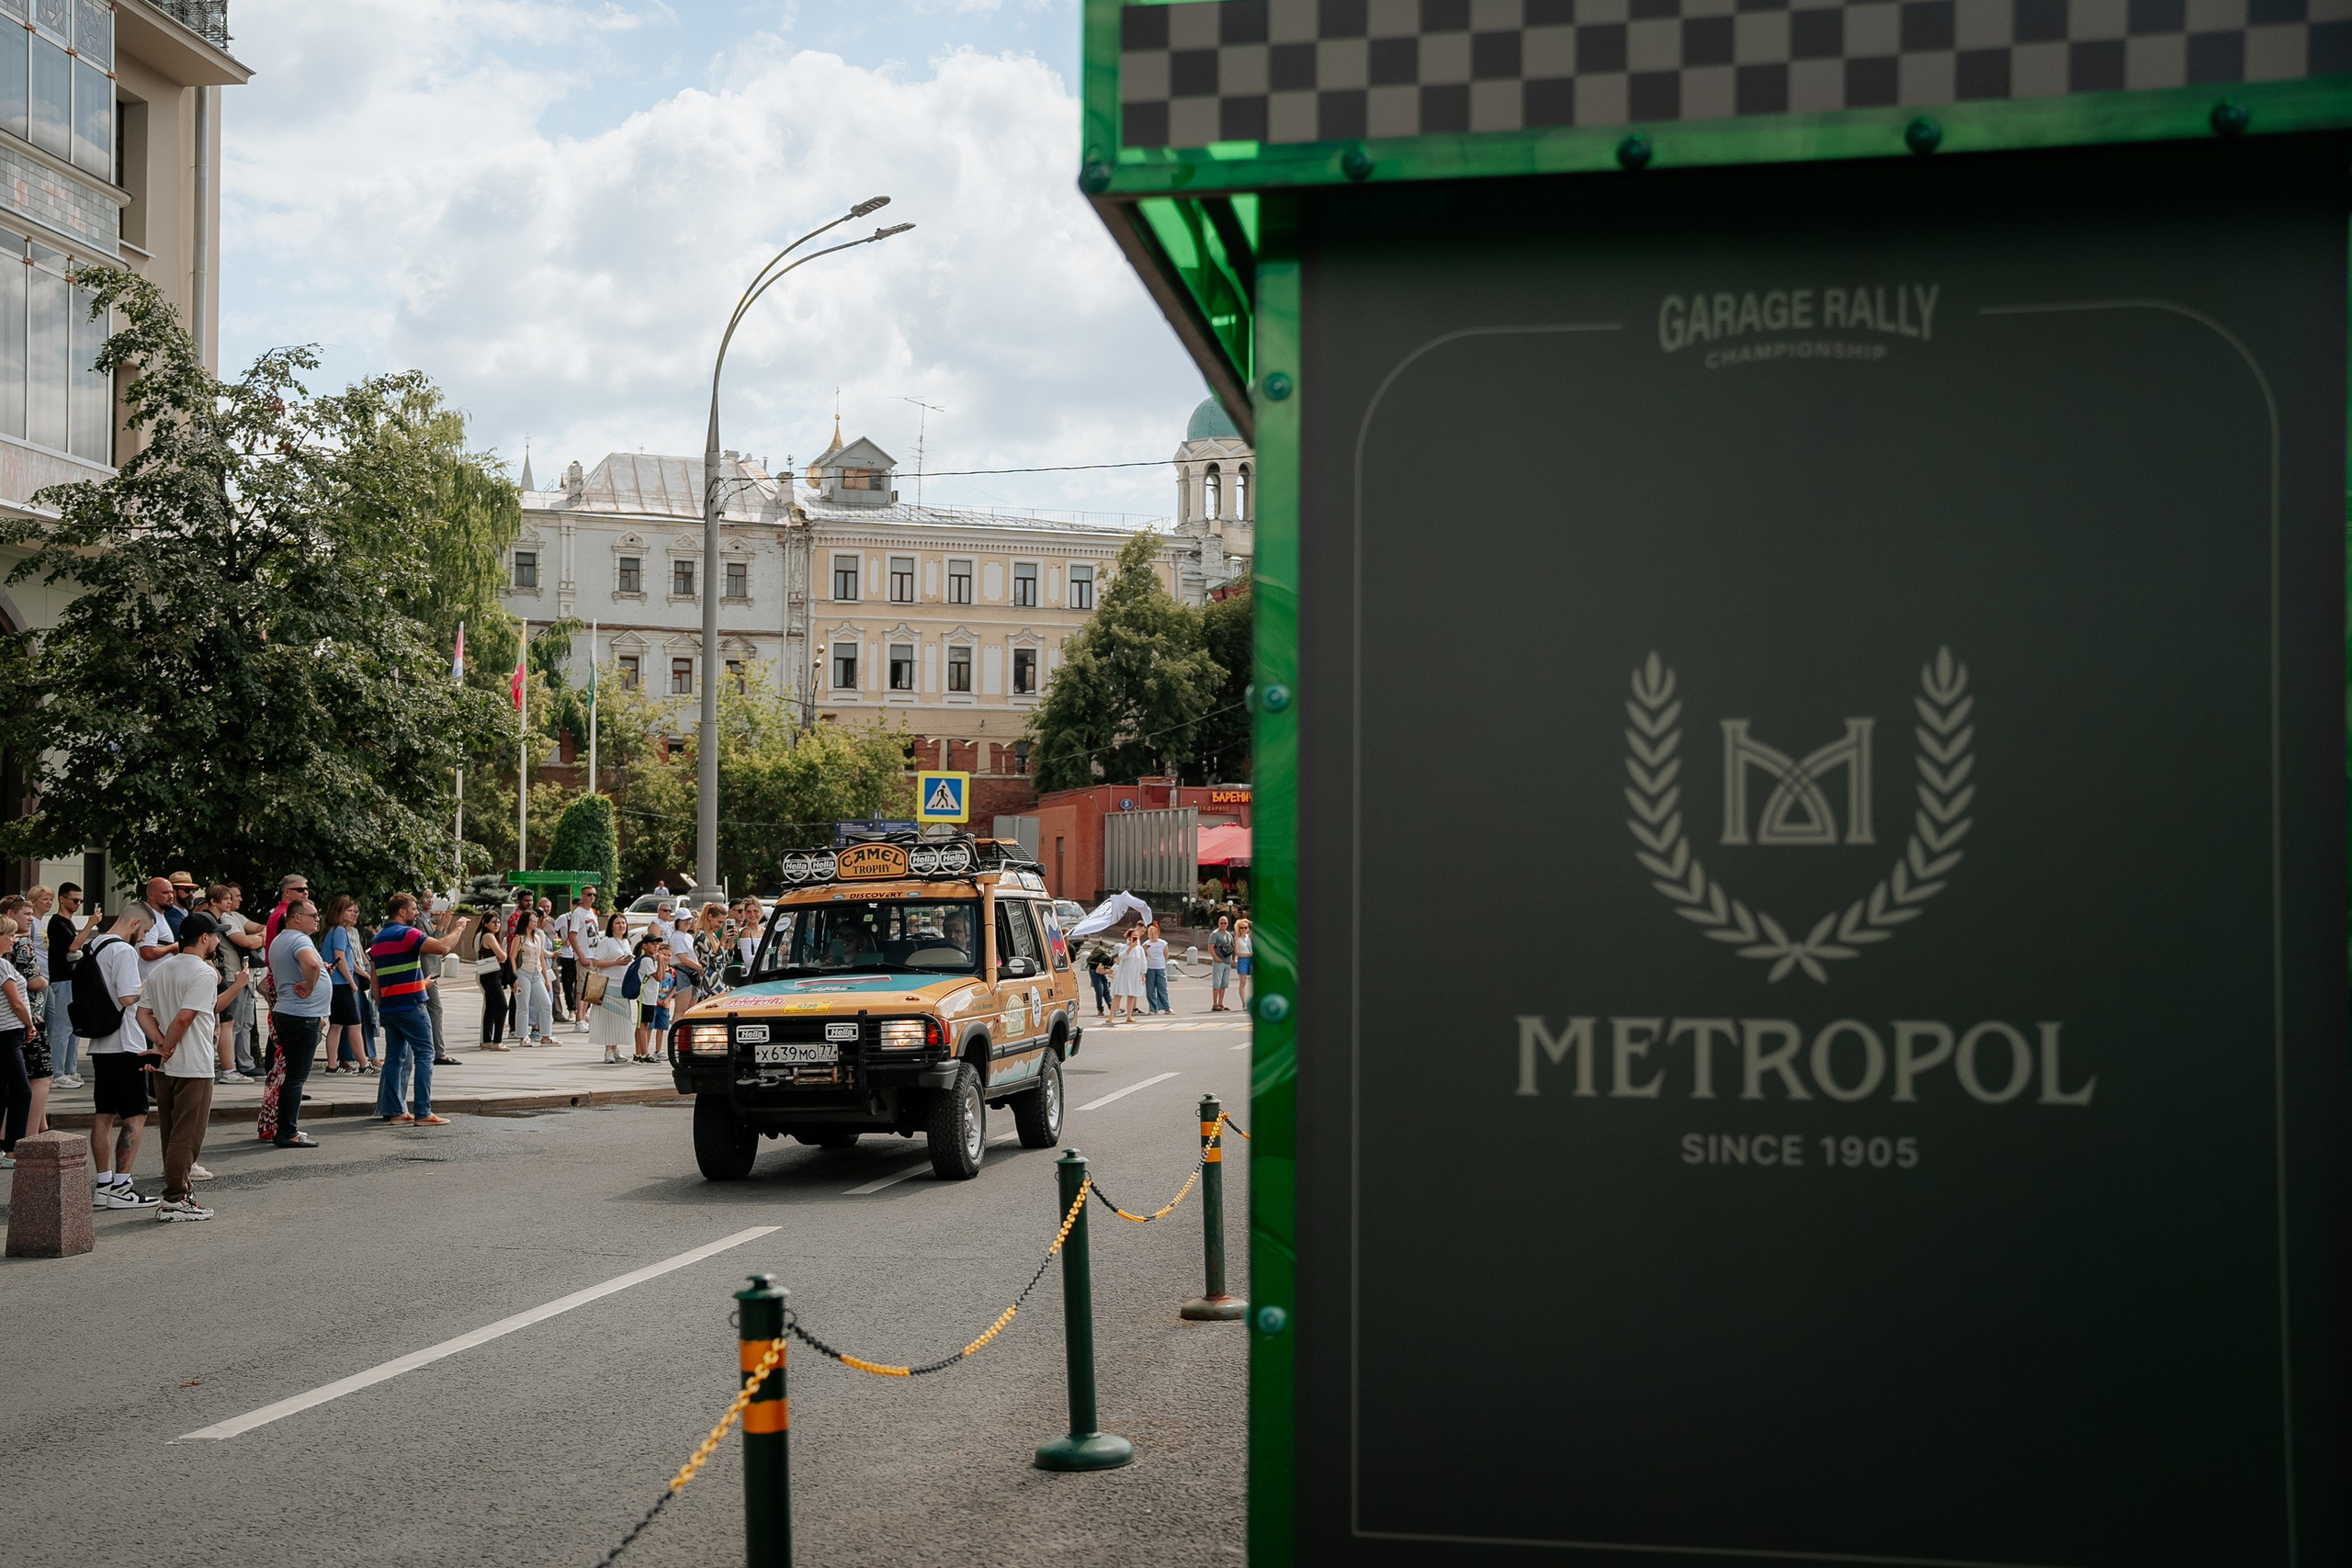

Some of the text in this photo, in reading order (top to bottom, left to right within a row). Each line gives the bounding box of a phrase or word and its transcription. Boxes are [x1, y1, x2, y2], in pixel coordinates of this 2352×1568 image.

[1657, 283, 1940, 354] GARAGE RALLY
[1705, 341, 1887, 369] CHAMPIONSHIP
[842, 849, 903, 867] CAMEL
[912, 855, 935, 863] Hella
[943, 853, 967, 862] Hella
[812, 861, 834, 869] Hella
[853, 863, 891, 874] TROPHY
[850, 891, 903, 899] DISCOVERY
[757, 998, 783, 1006] RALLY
[741, 1029, 763, 1038] Hella
[831, 1027, 854, 1036] Hella
[820, 1044, 833, 1055] 77
[1514, 1015, 2098, 1105] METROPOL
[1680, 1133, 1919, 1168] SINCE 1905
